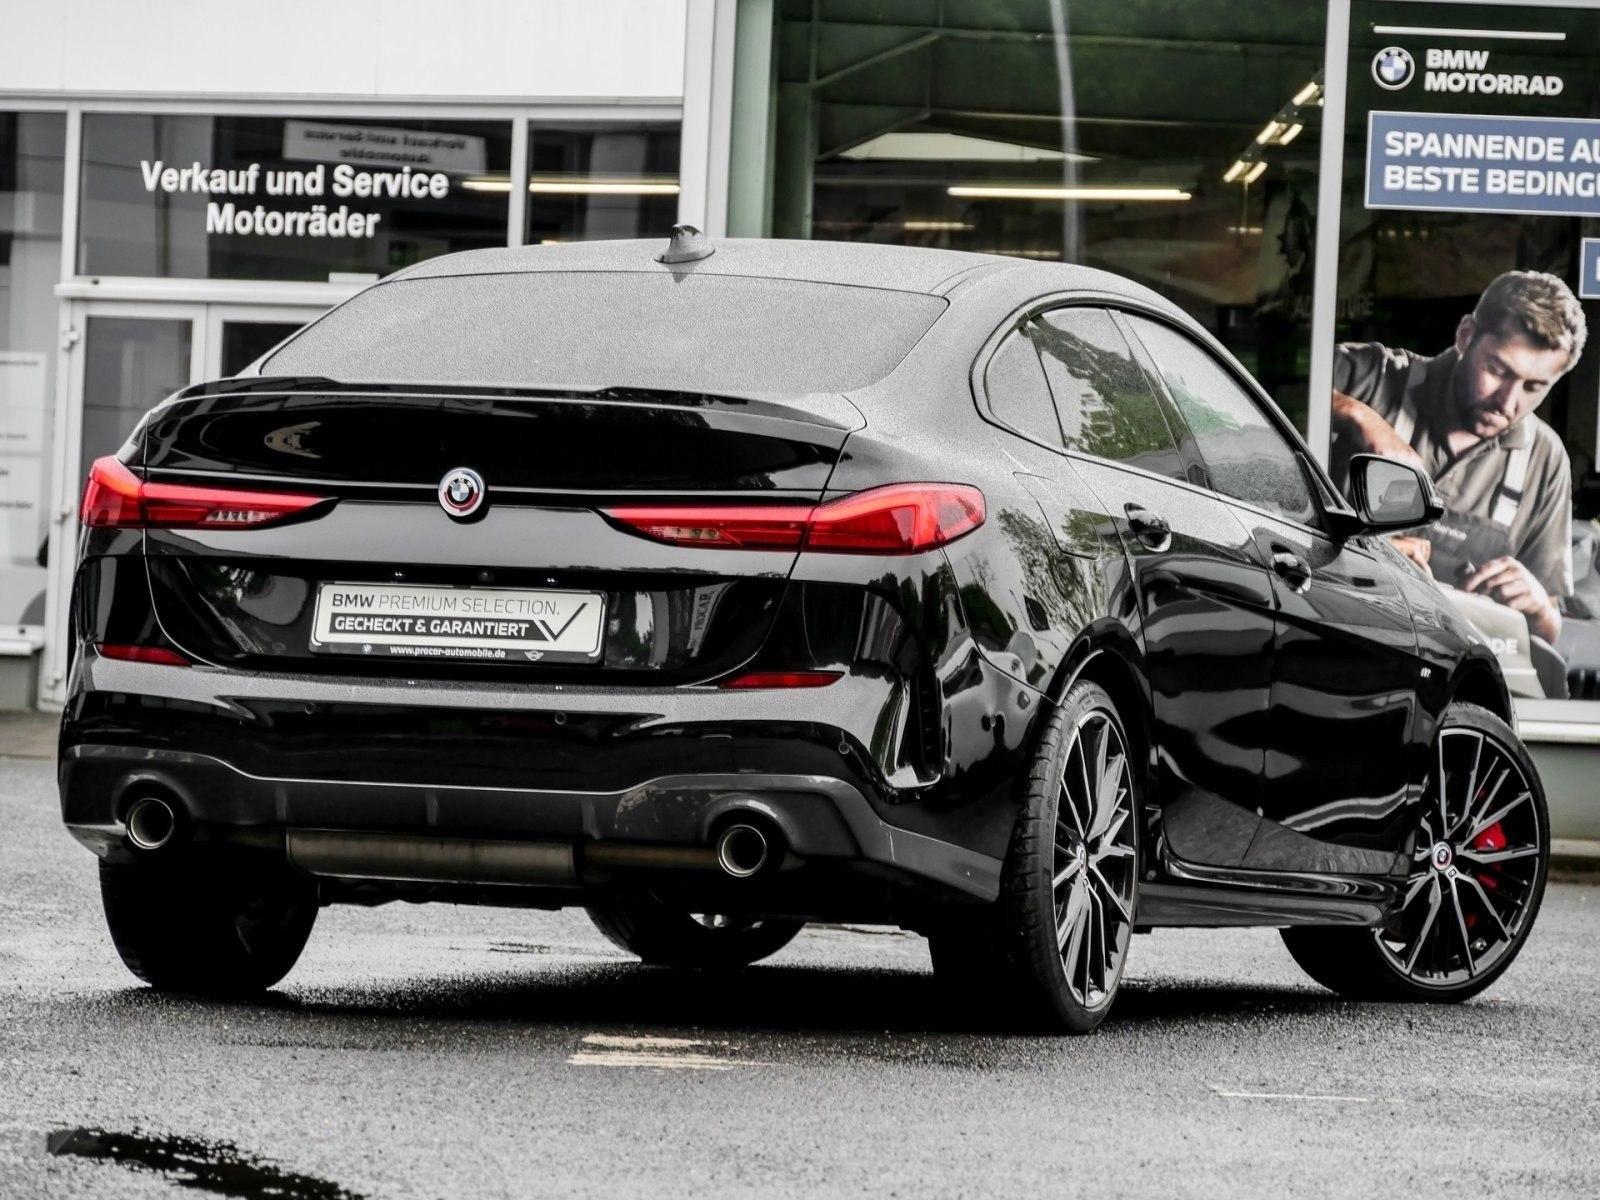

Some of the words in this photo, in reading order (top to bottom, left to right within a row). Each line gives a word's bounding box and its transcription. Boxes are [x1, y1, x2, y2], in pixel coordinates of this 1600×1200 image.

[1426, 48, 1490, 71] BMW
[1424, 71, 1564, 96] MOTORRAD
[1385, 131, 1565, 162] SPANNENDE
[141, 160, 260, 194] Verkauf
[265, 165, 325, 197] und
[332, 164, 450, 198] Service
[1384, 165, 1480, 193] BESTE
[1486, 169, 1600, 198] BEDING
[206, 202, 381, 238] Motorräder
[332, 593, 375, 607] BMW
[379, 595, 457, 611] PREMIUM
[461, 597, 560, 615] SELECTION.
[334, 615, 413, 633] GECHECKT
[414, 618, 426, 633] &
[430, 619, 530, 637] GARANTIERT
[390, 645, 506, 659] www.procar-automobile.de
